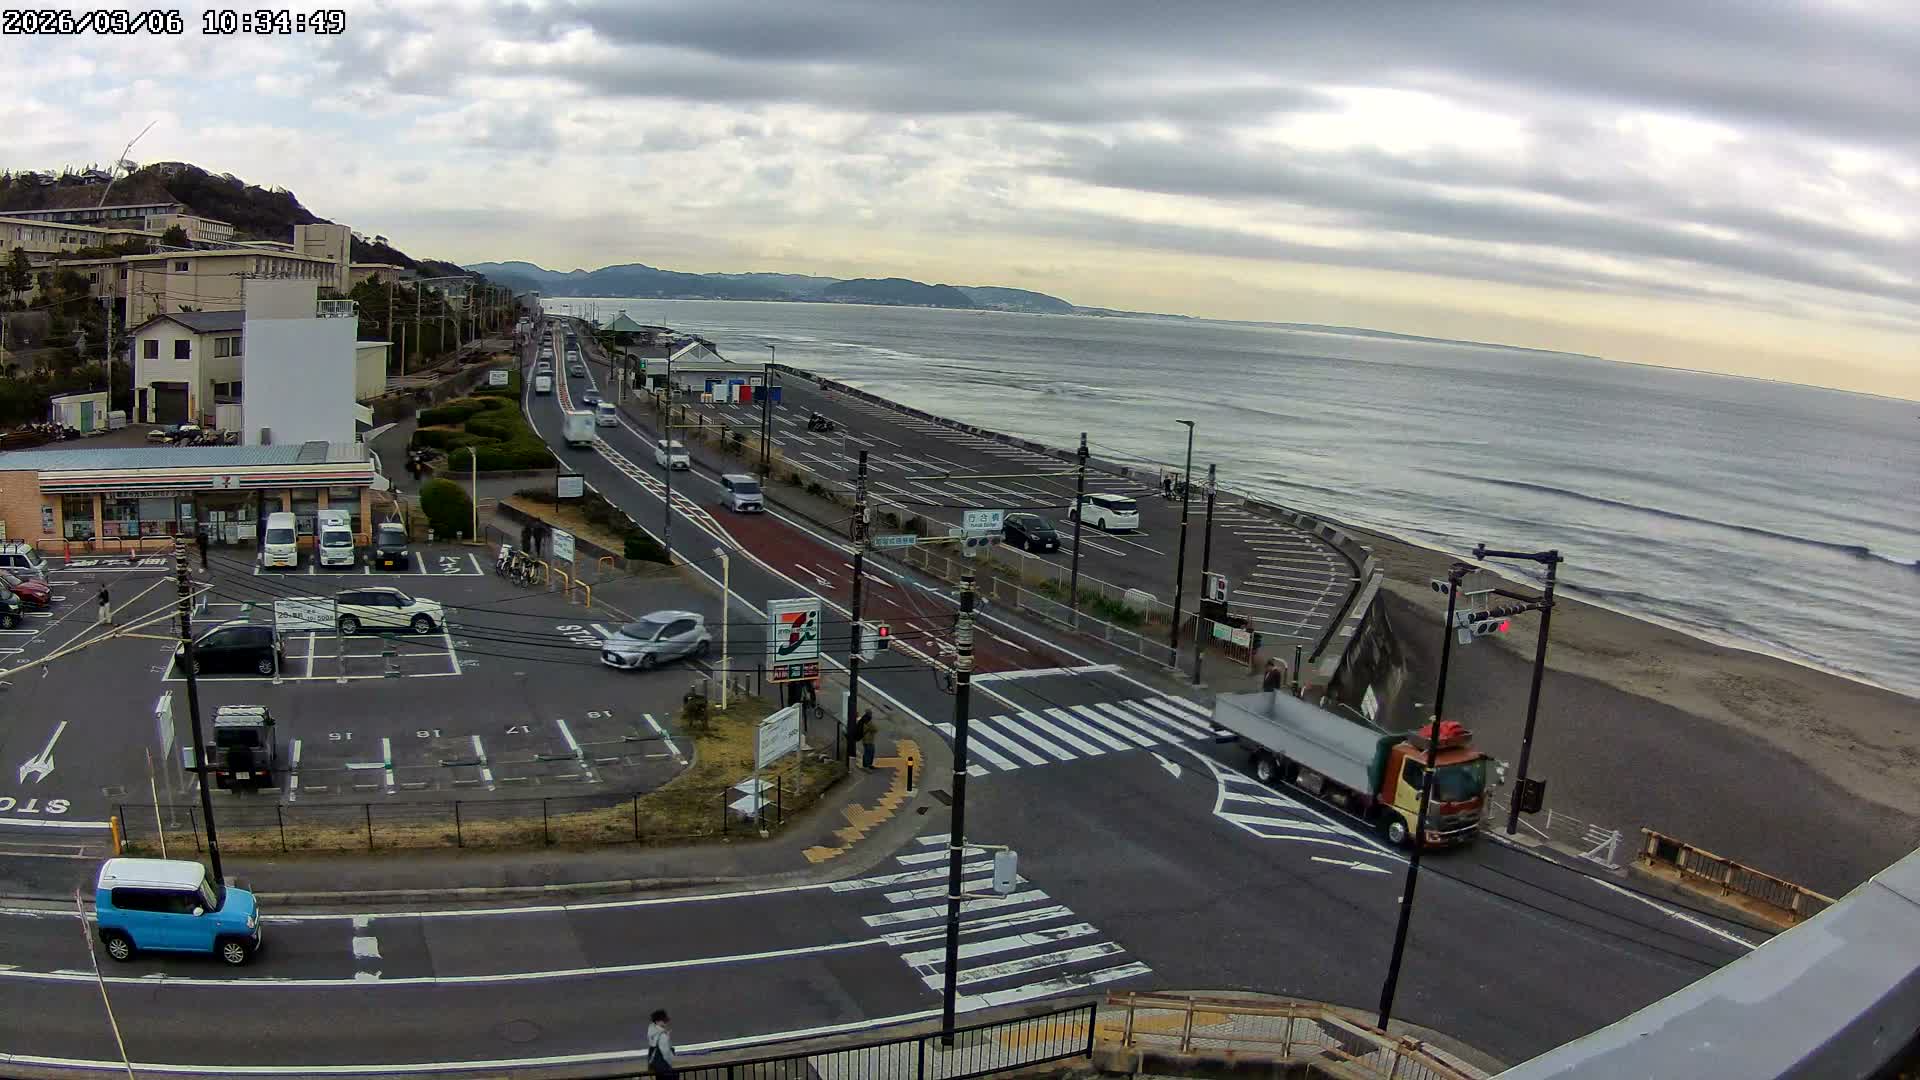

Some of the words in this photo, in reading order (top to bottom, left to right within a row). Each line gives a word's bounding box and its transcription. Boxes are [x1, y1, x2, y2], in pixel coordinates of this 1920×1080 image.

[556, 625, 603, 647] STOP
[587, 709, 614, 720] 18
[506, 724, 530, 734] 17
